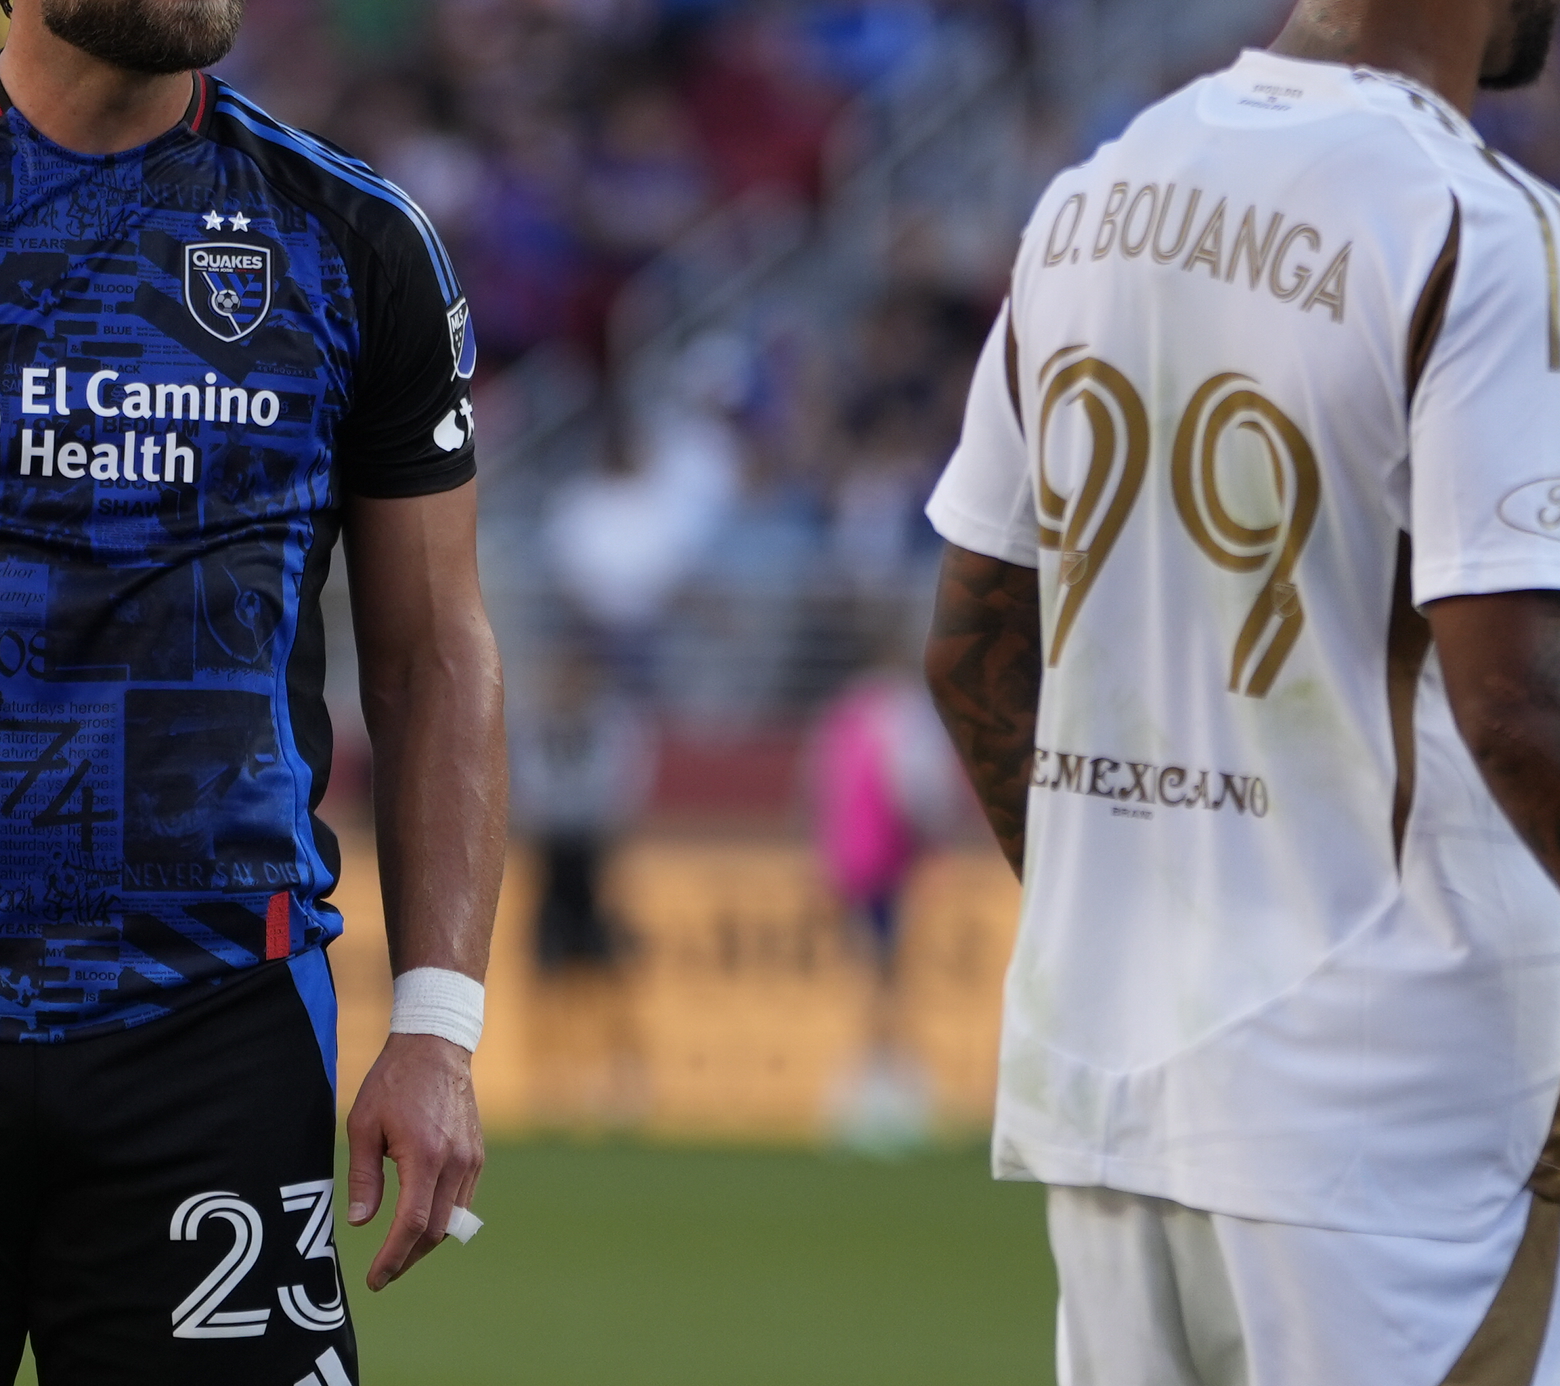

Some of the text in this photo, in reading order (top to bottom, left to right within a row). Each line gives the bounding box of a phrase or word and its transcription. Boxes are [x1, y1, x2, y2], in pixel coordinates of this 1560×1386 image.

[19, 238, 67, 250] YEARS
[192, 250, 263, 270] QUAKES
[1043, 181, 1354, 325] D. BOUANGA
[93, 282, 134, 294] BLOOD
[103, 303, 114, 313] IS
[450, 309, 464, 332] MLS
[103, 325, 132, 335] BLUE
[21, 366, 70, 416] El
[85, 370, 280, 428] Camino
[102, 416, 200, 438] BEDLAM
[19, 428, 195, 484] Health
[1037, 343, 1322, 700] 99
[69, 700, 117, 714] heroes
[67, 821, 118, 837] heoes
[67, 838, 118, 853] heoes
[124, 862, 204, 888] NEVER
[264, 862, 301, 885] DIE
[46, 947, 65, 958] MY
[75, 970, 117, 982] BLOOD
[85, 992, 96, 1003] IS
[169, 1178, 346, 1339] 23
